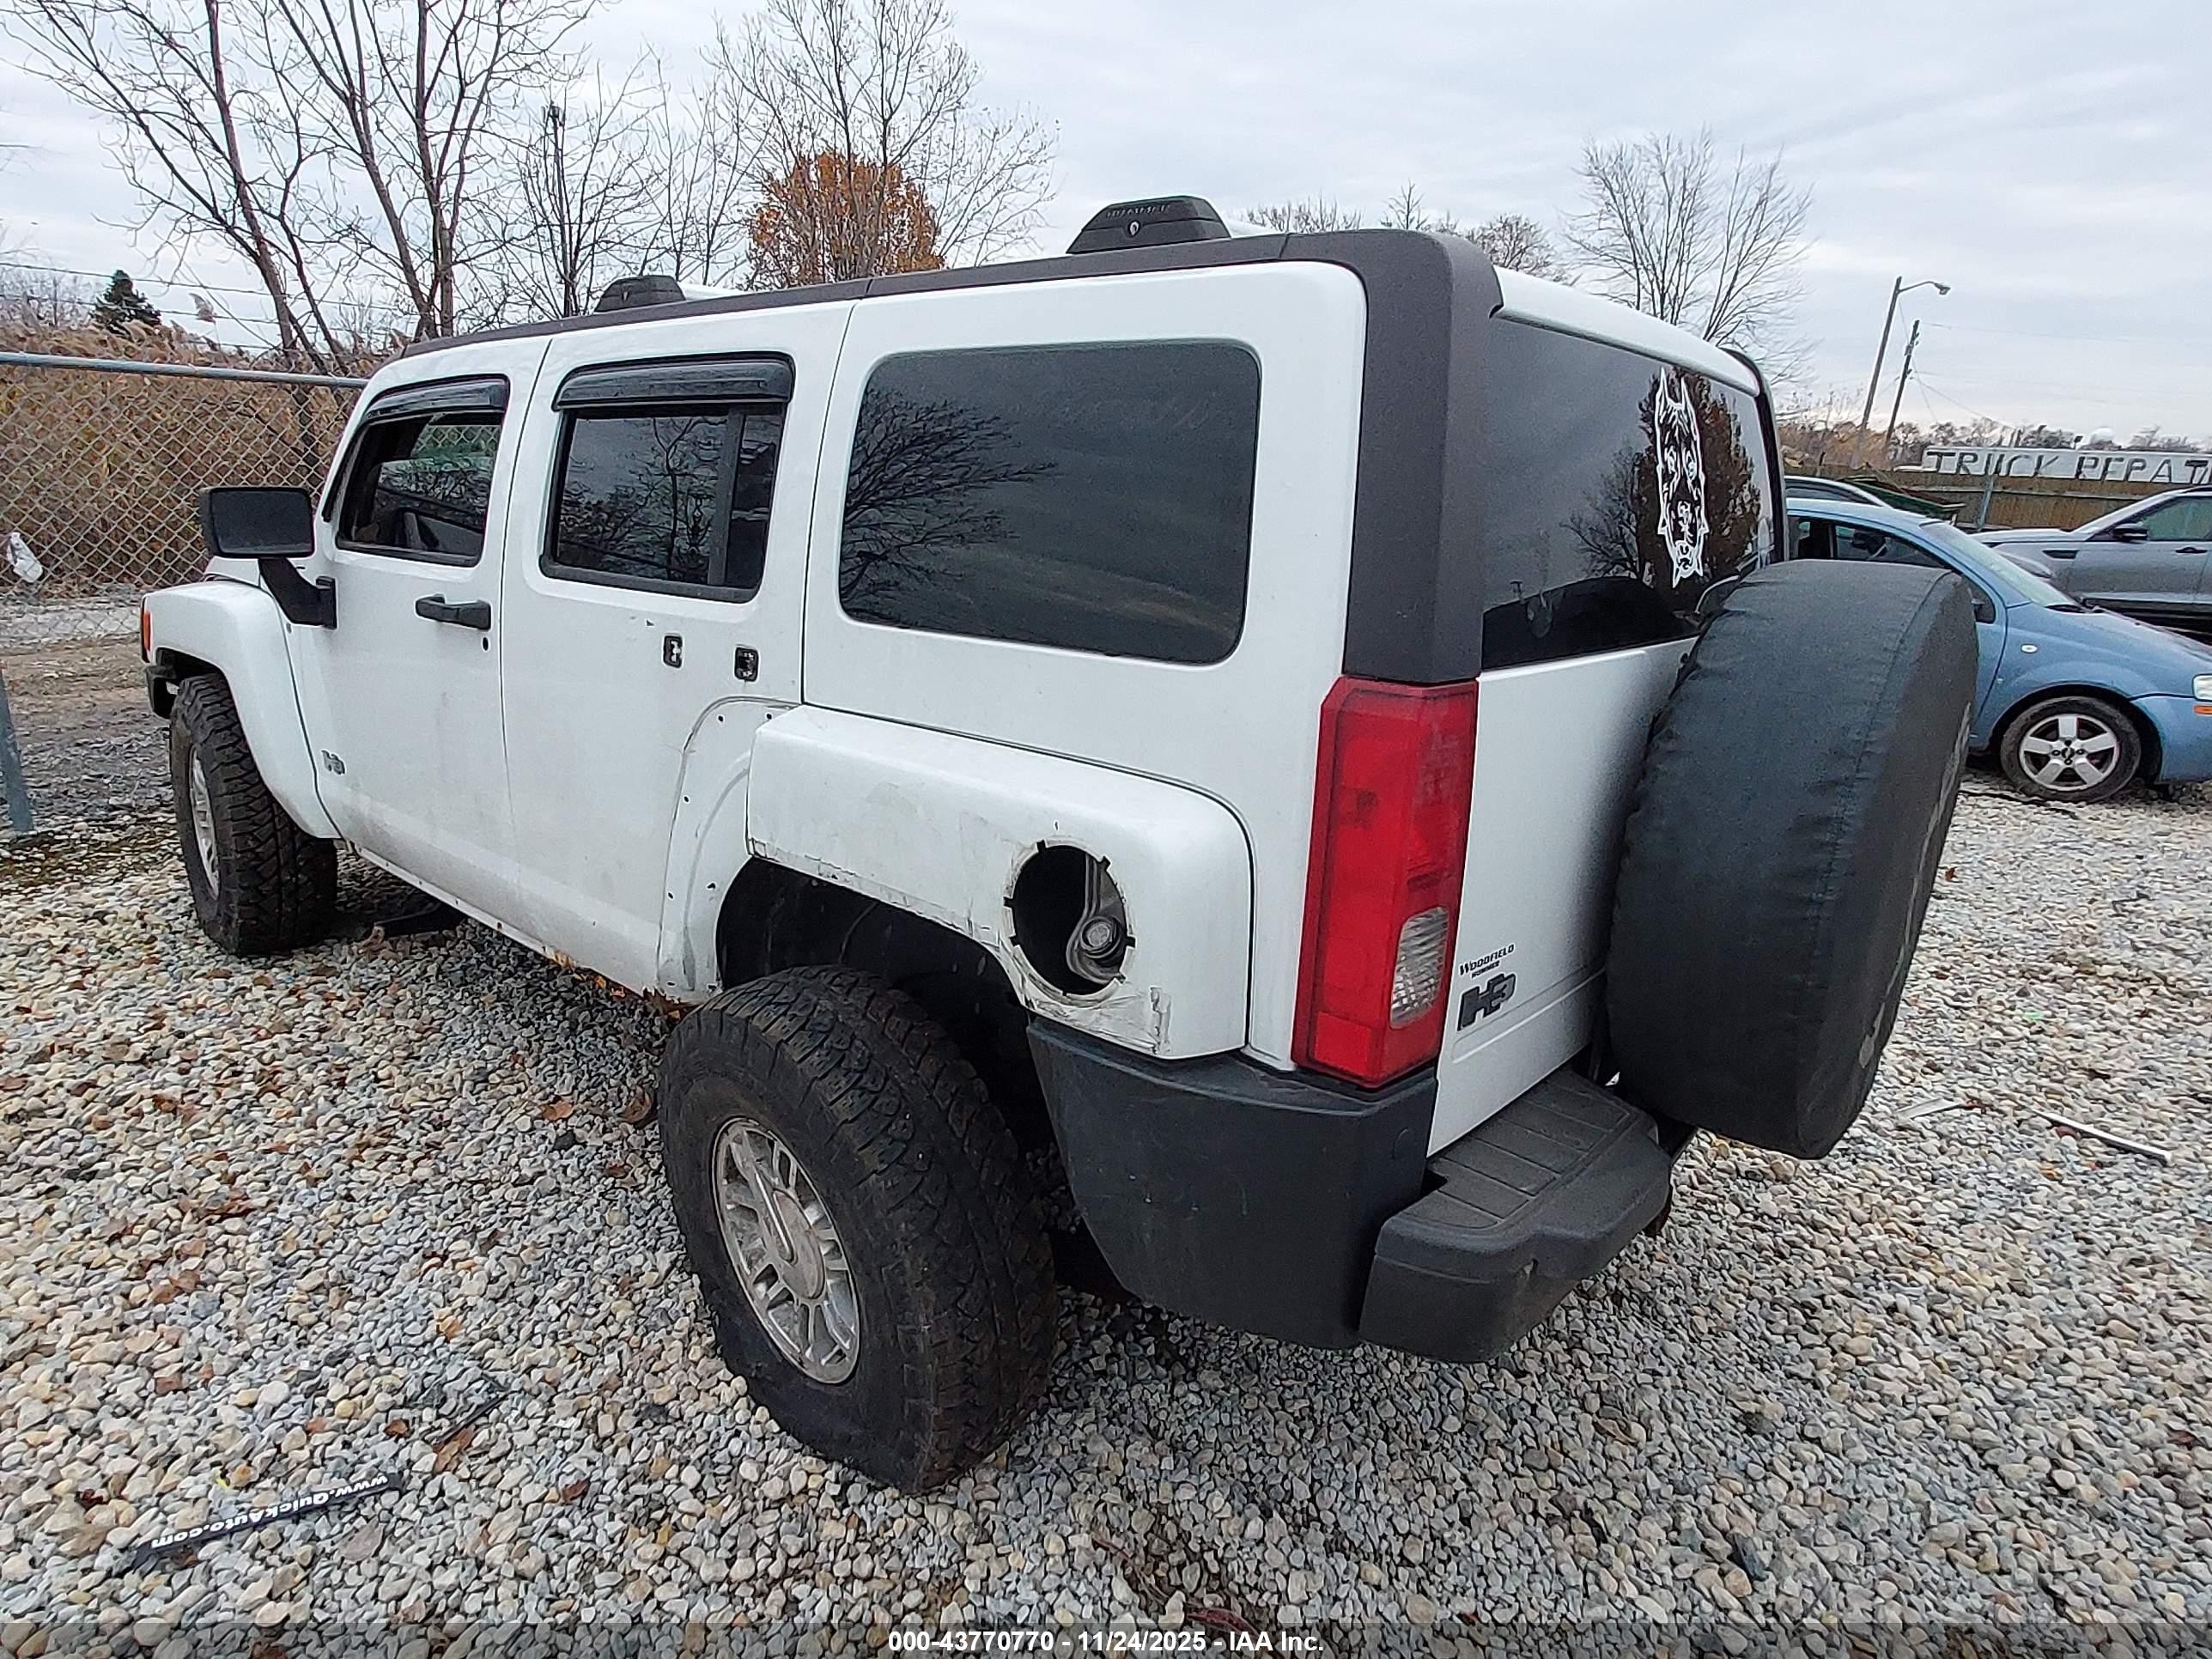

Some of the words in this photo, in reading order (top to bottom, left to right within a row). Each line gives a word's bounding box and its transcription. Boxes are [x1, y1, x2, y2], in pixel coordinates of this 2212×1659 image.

[1926, 450, 2059, 477] TRUCK
[1456, 973, 1516, 1031] H3
[151, 1474, 388, 1548] www.QuickAuto.com
